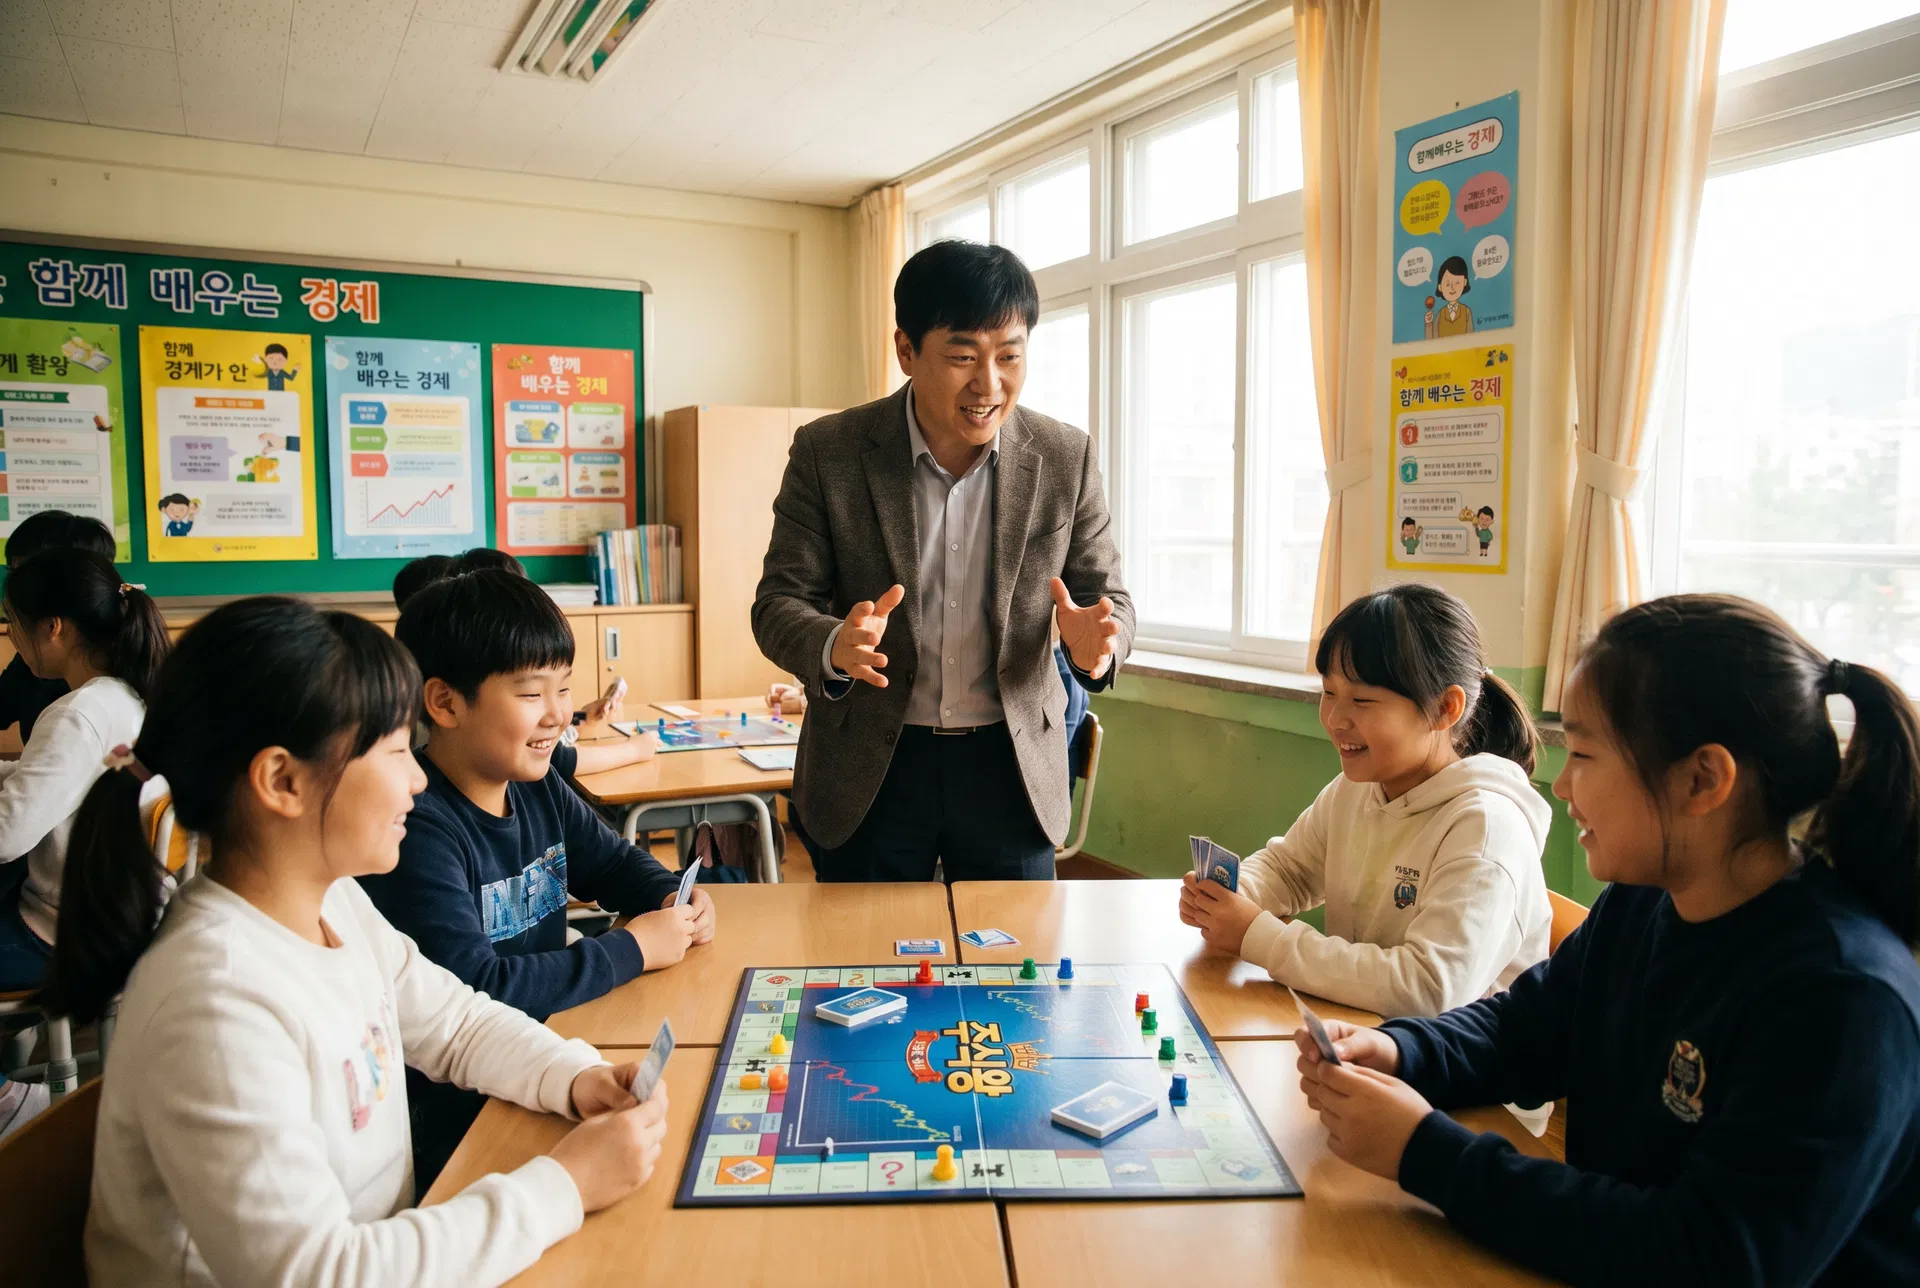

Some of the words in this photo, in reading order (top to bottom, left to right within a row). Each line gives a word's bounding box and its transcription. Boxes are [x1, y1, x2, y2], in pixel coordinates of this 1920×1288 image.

[1467, 125, 1496, 151] 경제
[29, 257, 128, 309] 함께
[150, 268, 282, 318] 배우는
[300, 277, 381, 325] 경제
[163, 341, 193, 358] 함께
[356, 350, 383, 367] 함께
[229, 362, 248, 383] 안
[548, 354, 581, 376] 함께
[357, 369, 410, 389] 배우는
[416, 371, 450, 391] 경제
[521, 374, 571, 396] 배우는
[576, 375, 608, 397] 경제
[1400, 387, 1424, 407] 함께
[1428, 384, 1466, 403] 배우는
[1470, 376, 1502, 401] 경제
[941, 1020, 1015, 1099] 주식왕
